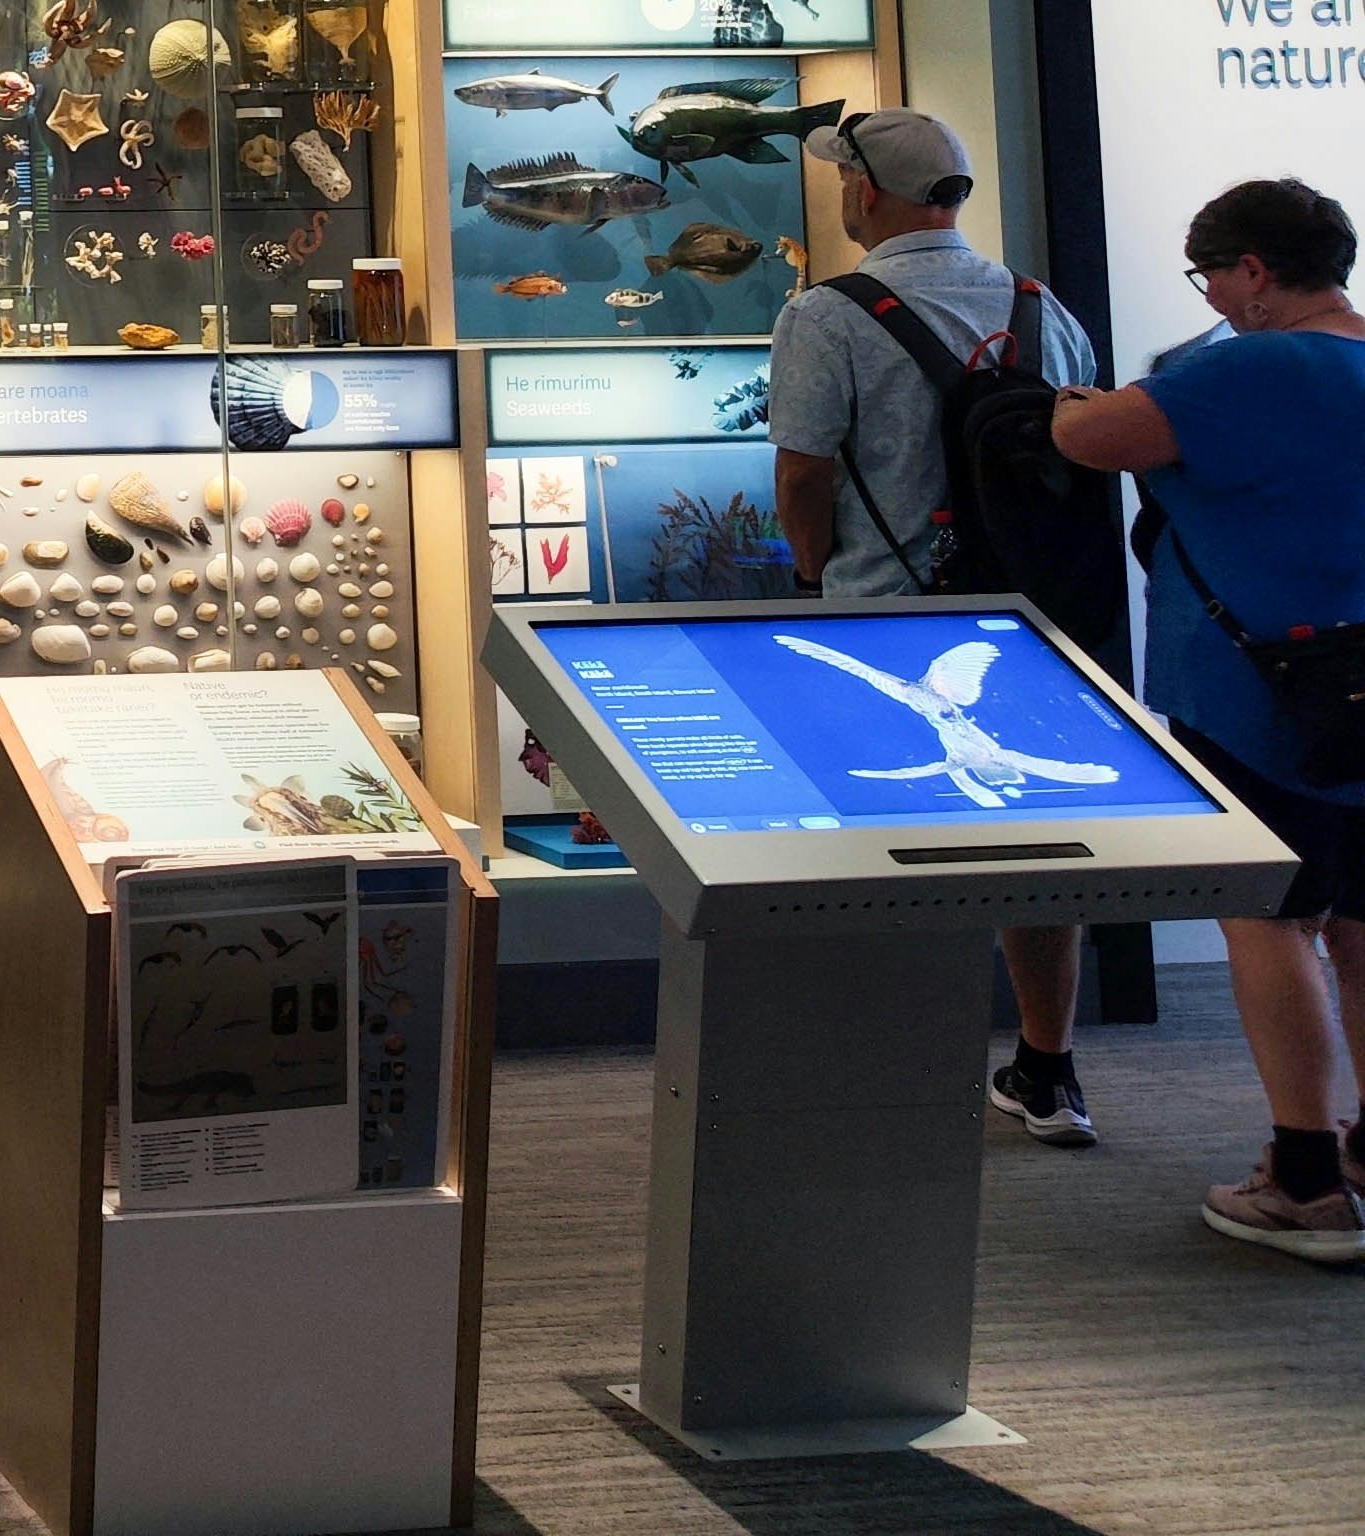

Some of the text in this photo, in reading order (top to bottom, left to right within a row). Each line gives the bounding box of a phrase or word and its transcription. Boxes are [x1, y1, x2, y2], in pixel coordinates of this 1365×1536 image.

[1217, 40, 1365, 89] natur
[506, 374, 611, 392] He rimurimu
[30, 384, 89, 399] moana
[344, 393, 377, 408] 55%
[506, 400, 591, 416] Seaweeds
